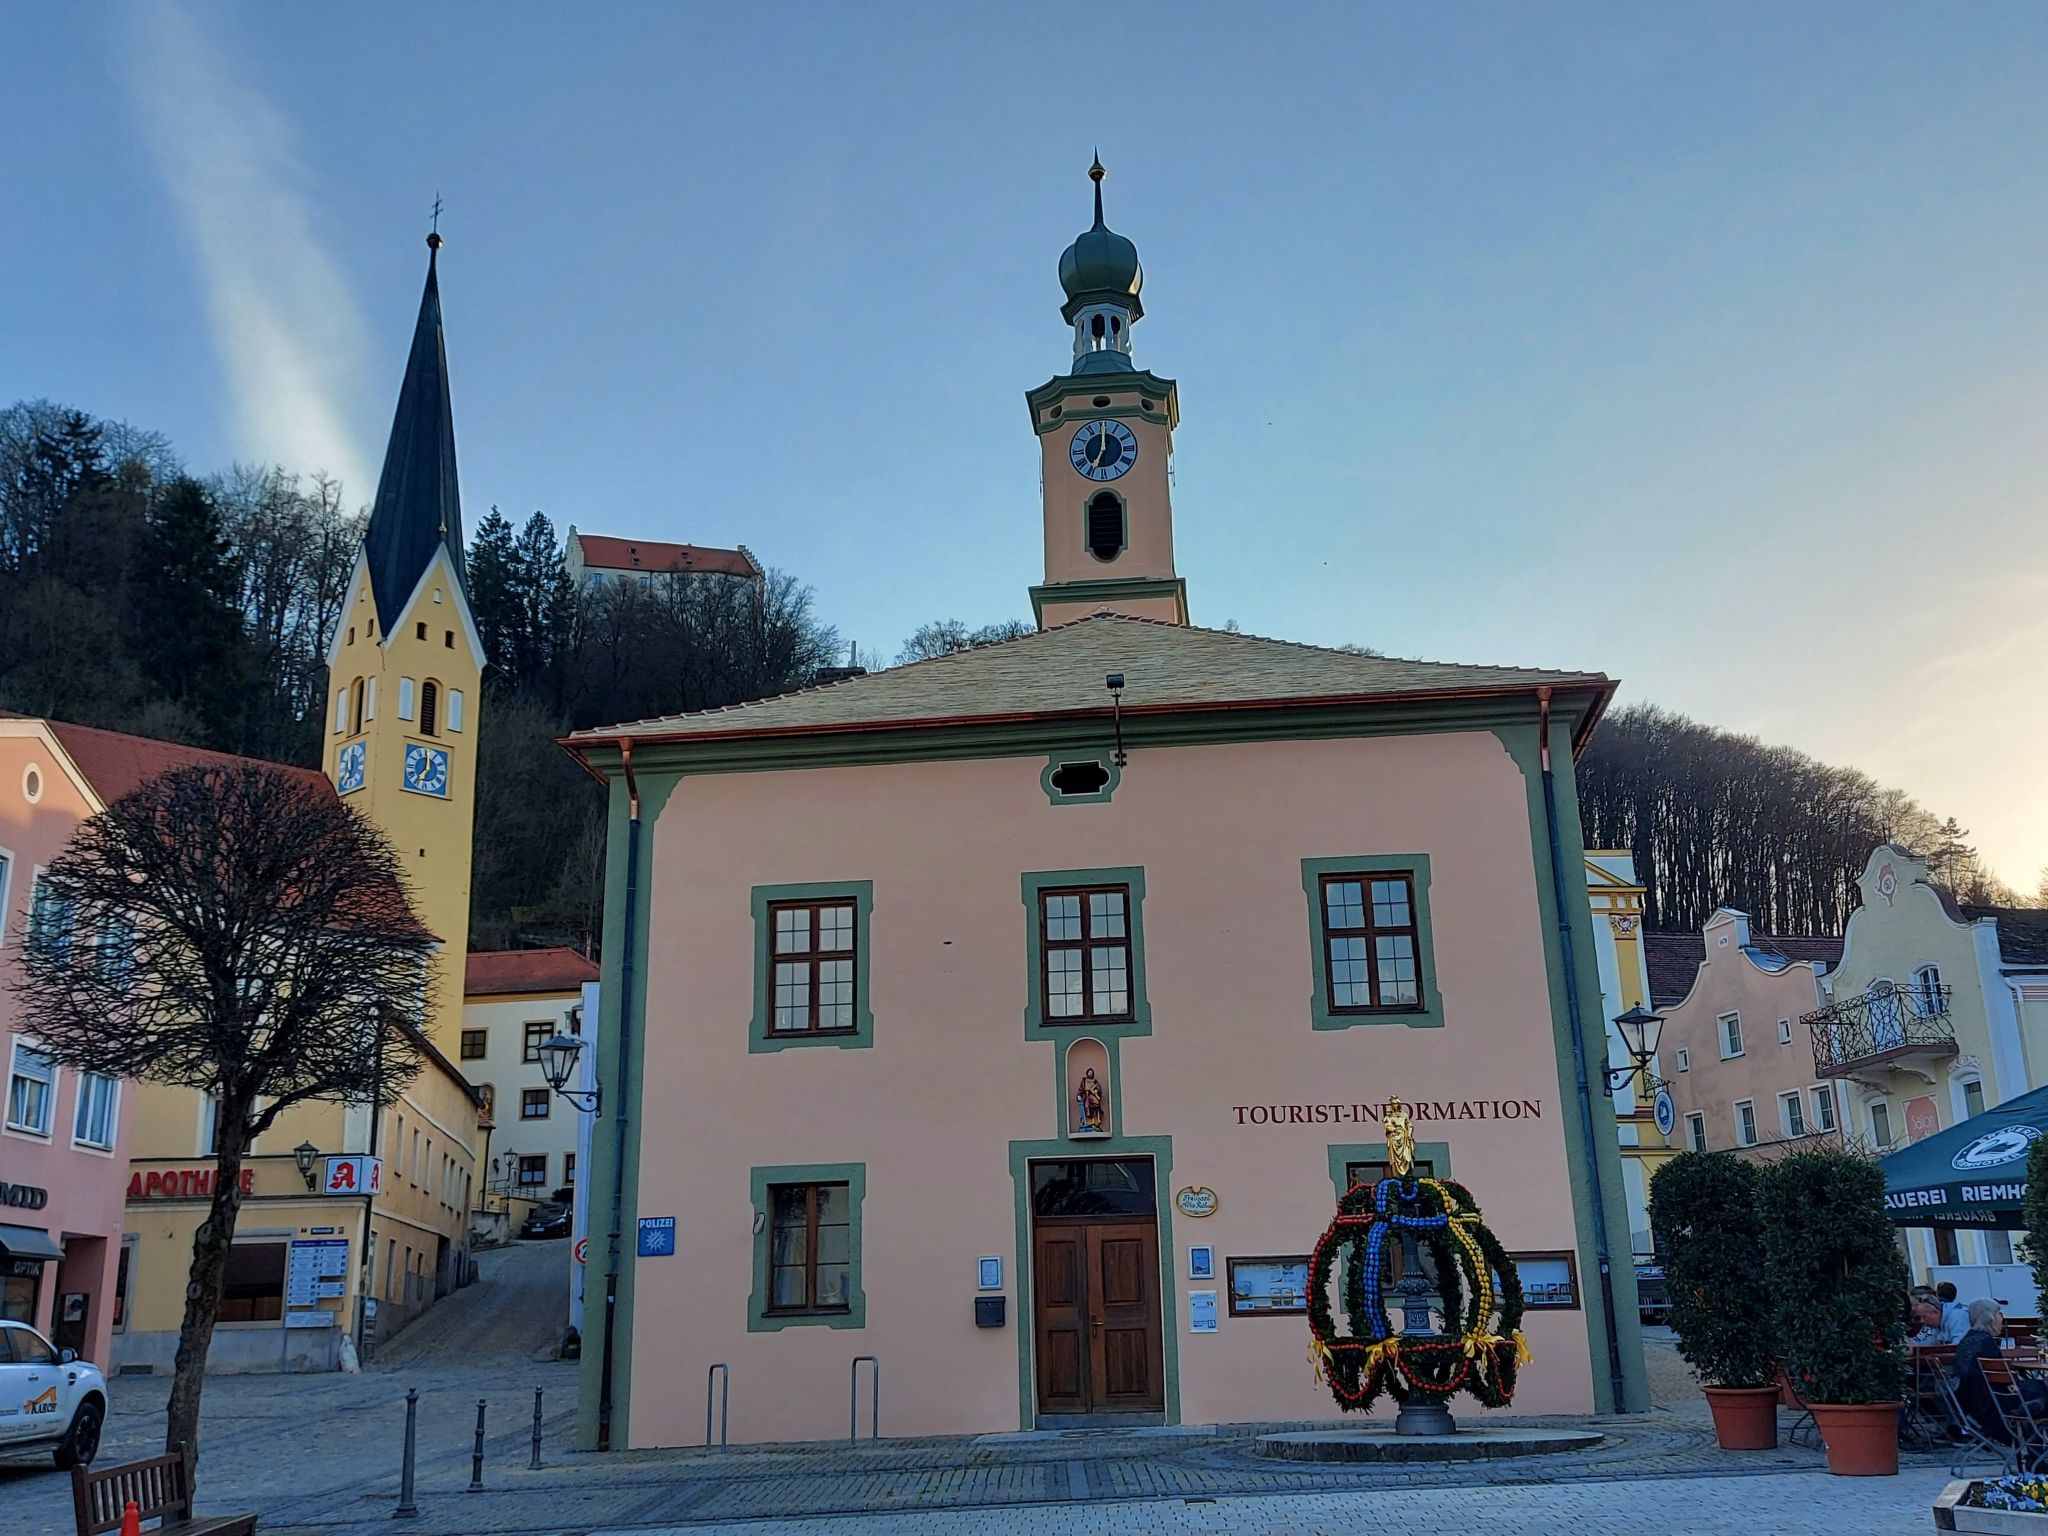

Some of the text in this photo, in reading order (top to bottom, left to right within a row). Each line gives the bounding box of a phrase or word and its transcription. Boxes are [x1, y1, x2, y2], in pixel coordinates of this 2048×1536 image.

[126, 1168, 254, 1197] APOTHE
[1884, 1188, 1947, 1210] AUEREI
[639, 1218, 674, 1229] POLIZEI
[14, 1260, 41, 1276] OPTIK
